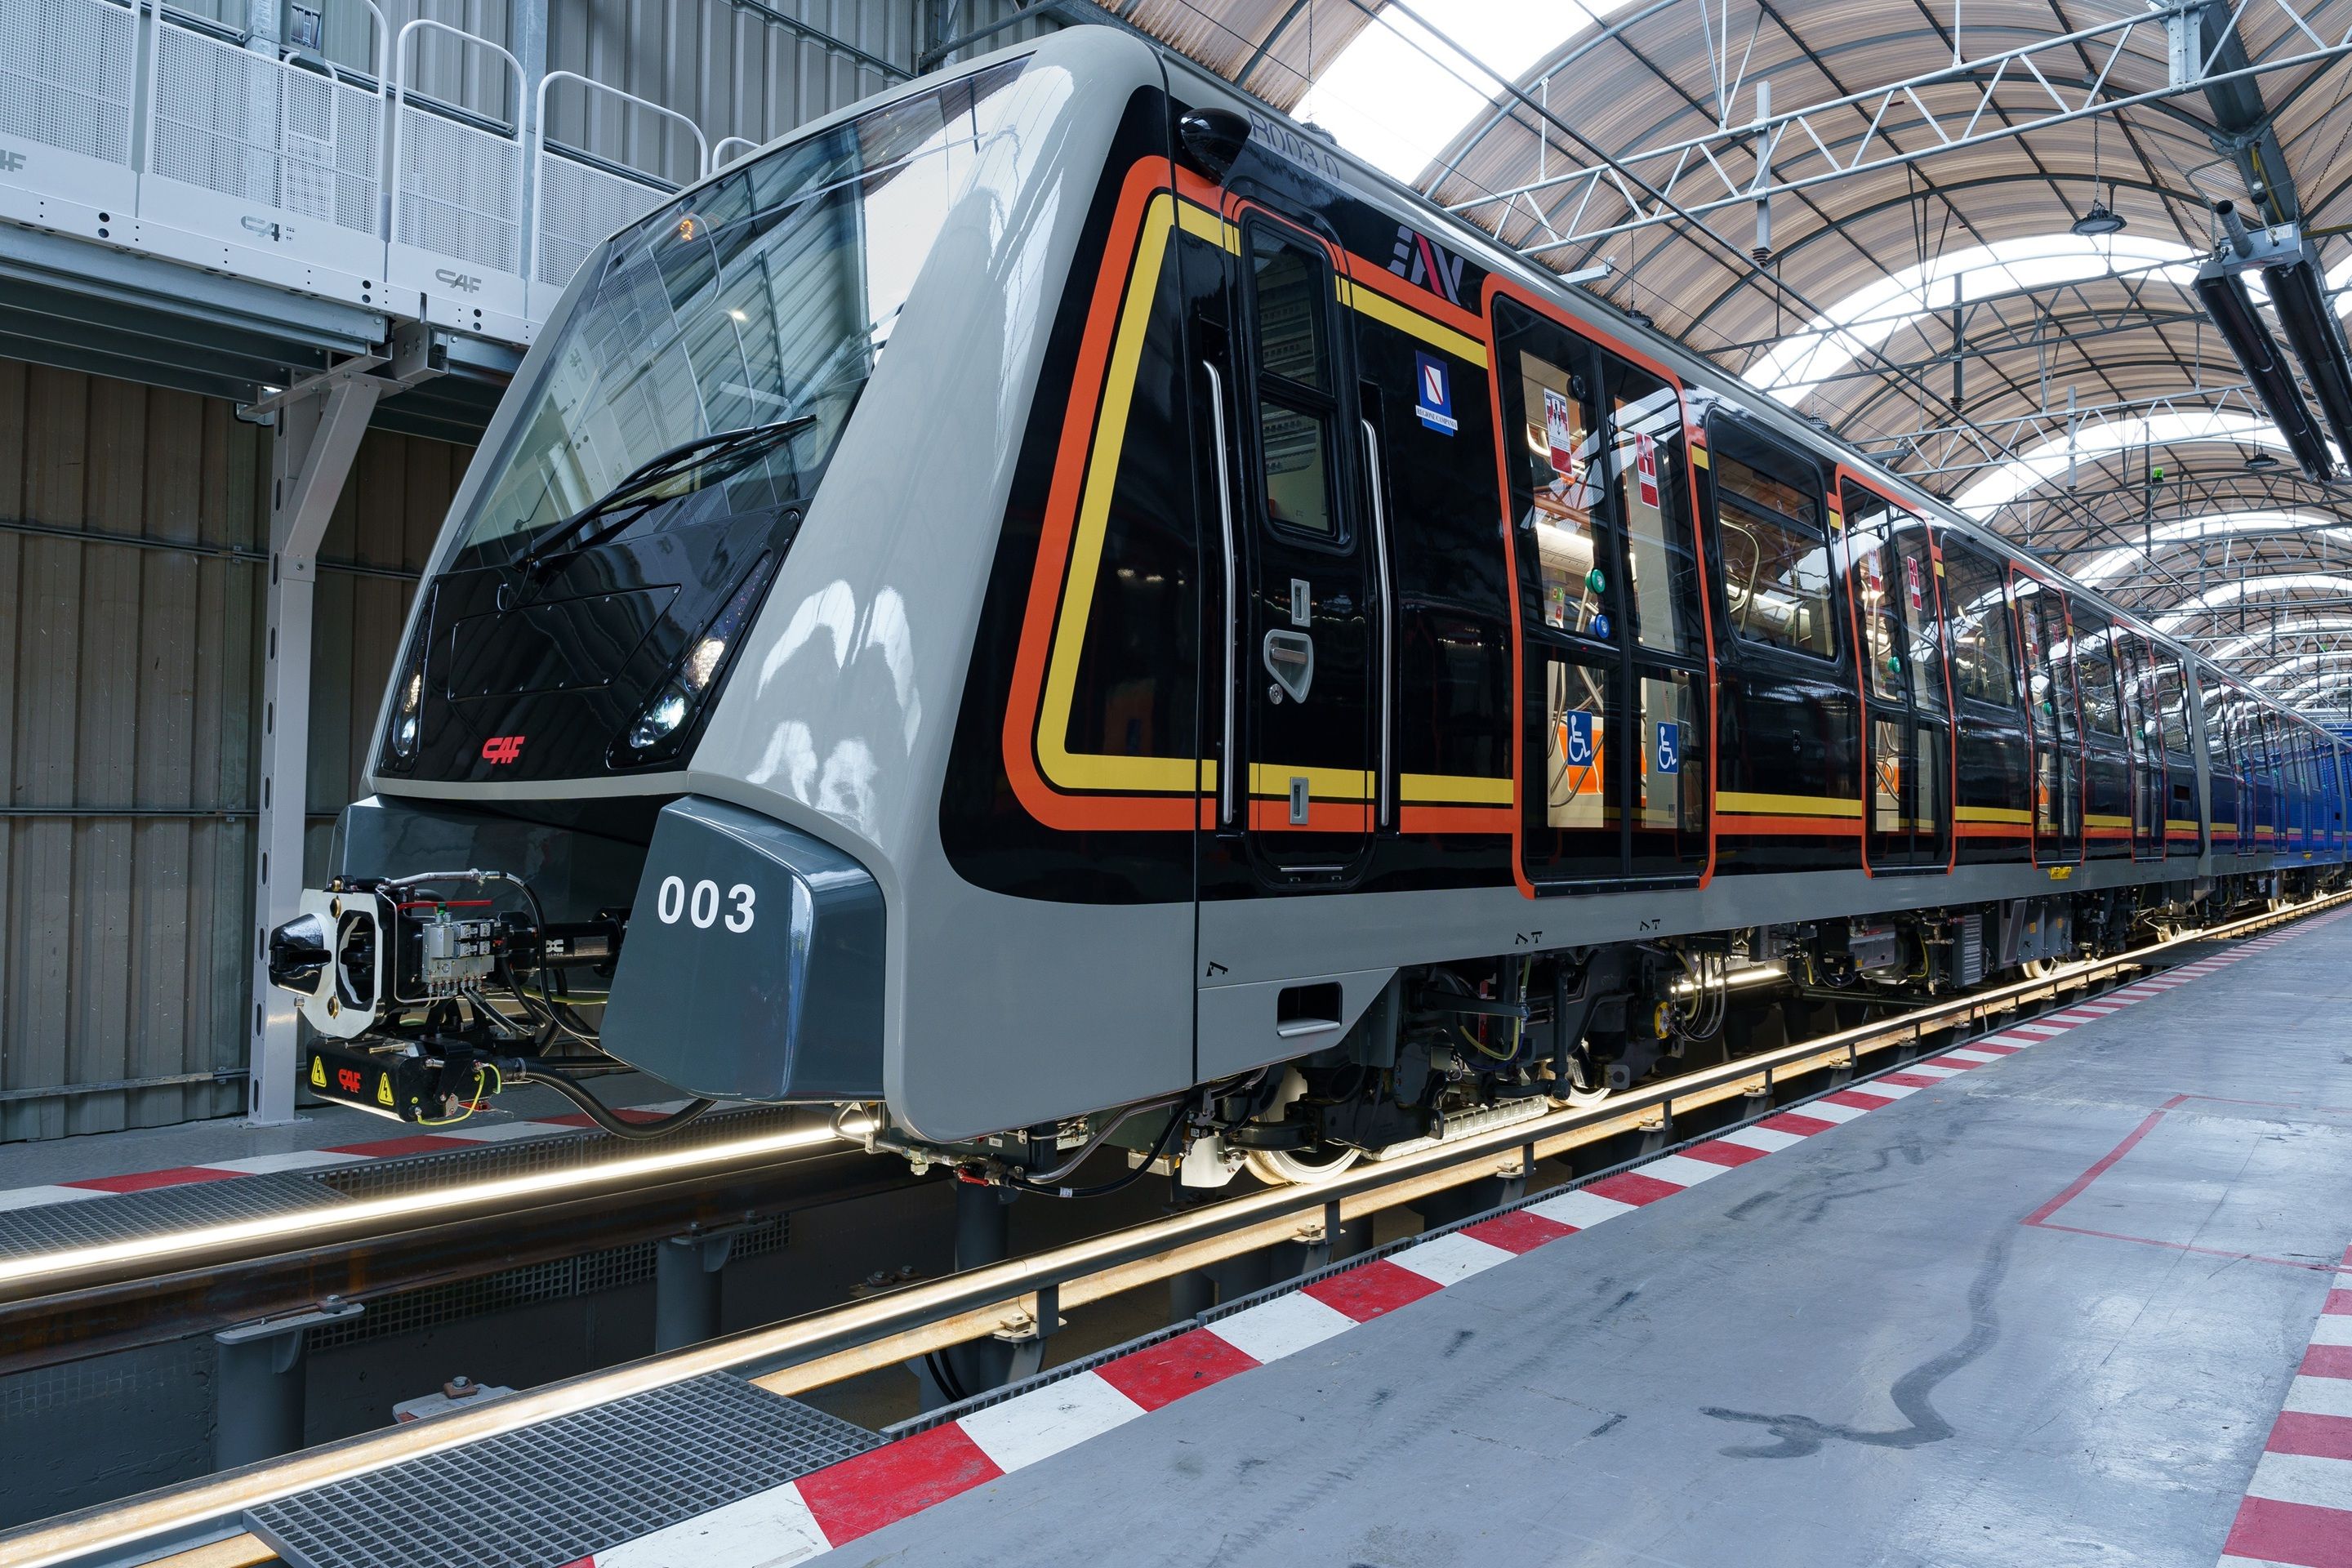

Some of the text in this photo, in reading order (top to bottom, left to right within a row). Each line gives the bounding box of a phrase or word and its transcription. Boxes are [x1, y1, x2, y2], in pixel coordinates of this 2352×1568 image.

[1387, 225, 1463, 306] EAV
[435, 269, 482, 294] CAF
[483, 737, 525, 764] CAF
[657, 875, 755, 933] 003
[339, 1068, 361, 1094] CAF
